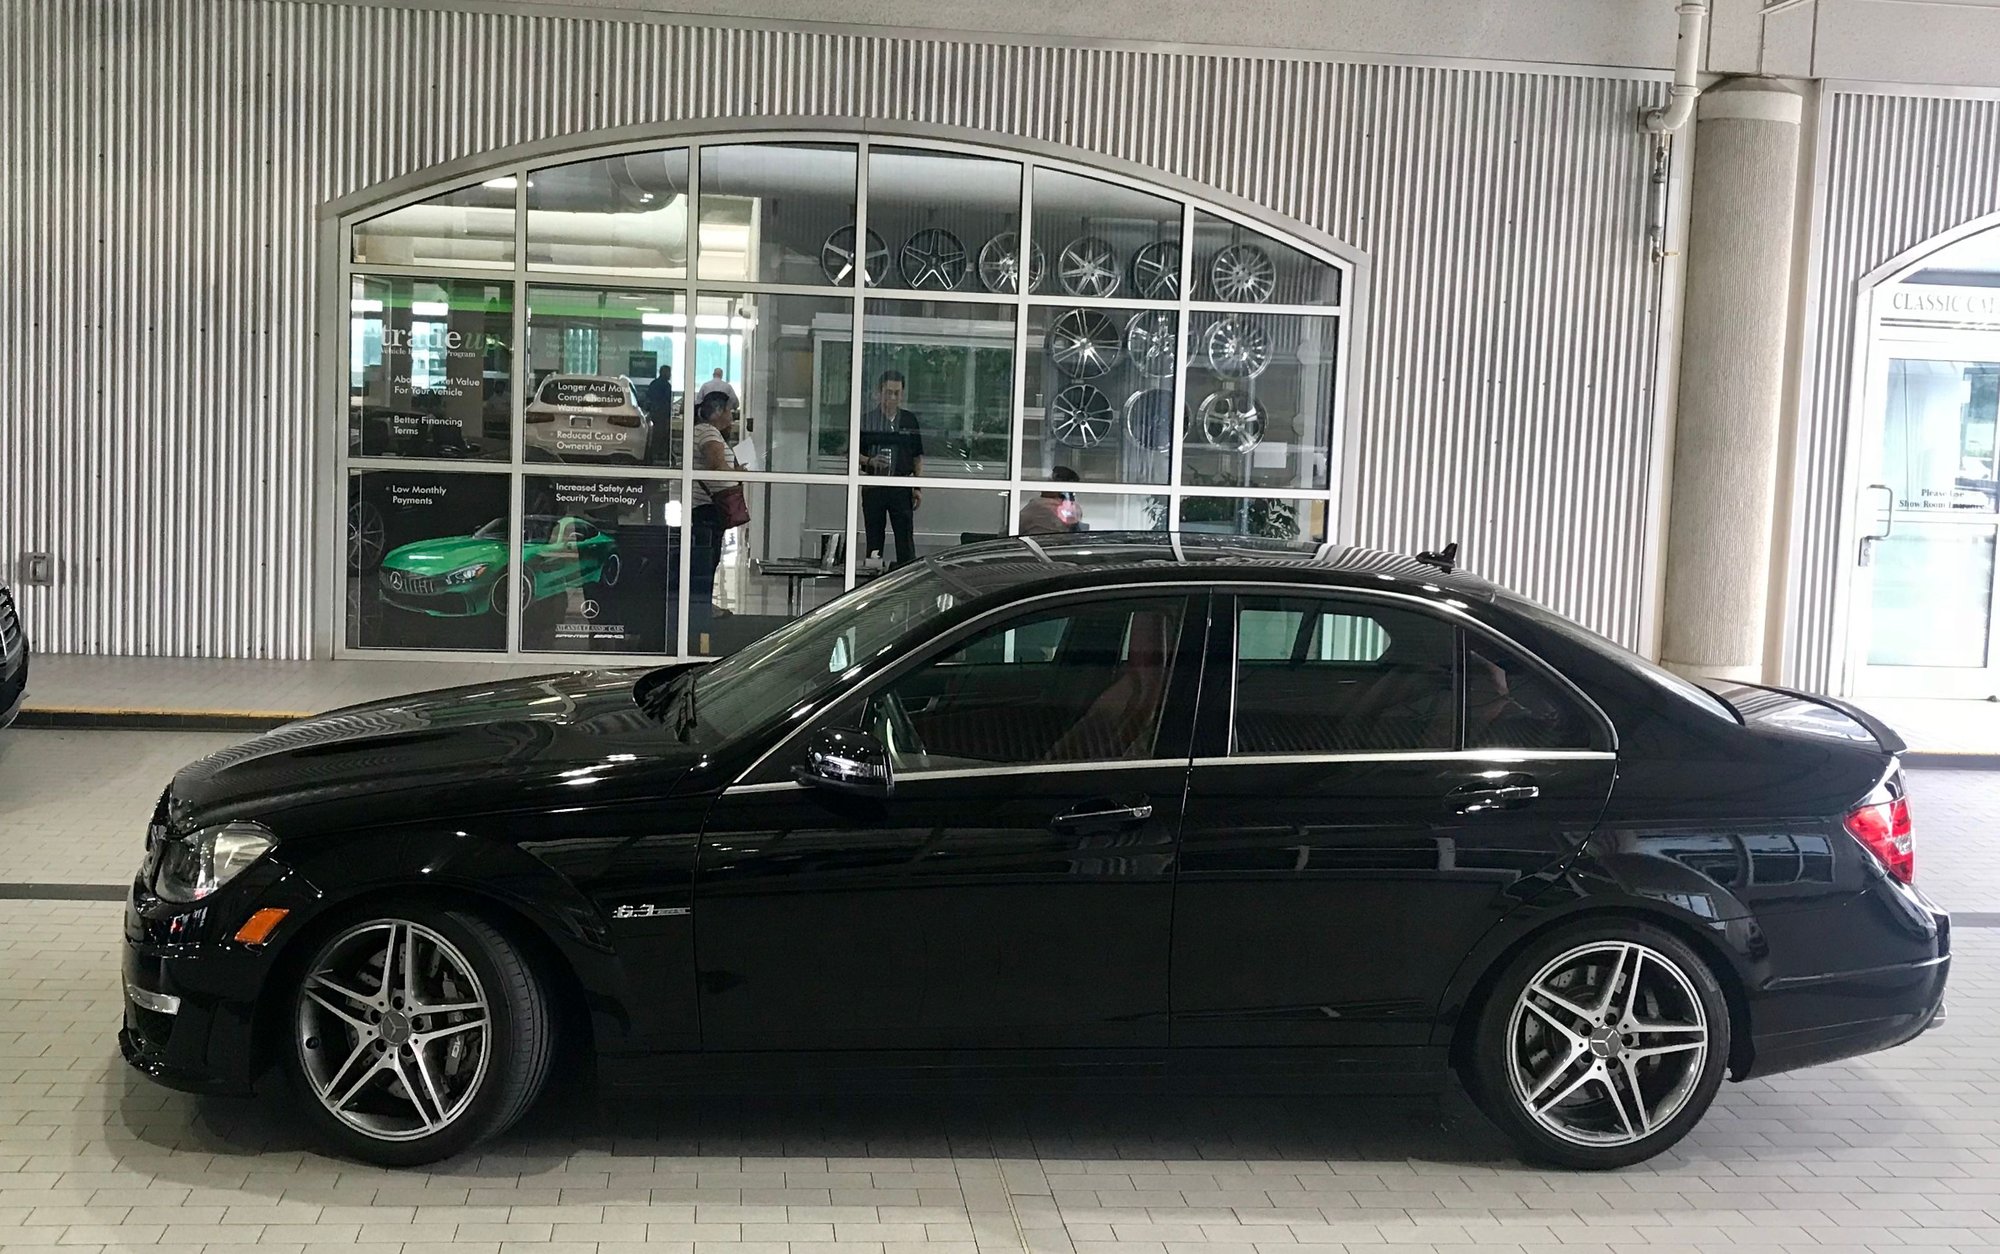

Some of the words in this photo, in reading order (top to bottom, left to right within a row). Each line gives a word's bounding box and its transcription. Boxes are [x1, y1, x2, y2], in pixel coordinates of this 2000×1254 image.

[1893, 292, 1959, 312] CLASSIC
[456, 377, 481, 387] Value
[394, 386, 409, 395] For
[410, 386, 431, 396] Your
[432, 388, 464, 397] Vehicle
[557, 382, 587, 392] Longer
[588, 383, 607, 393] And
[608, 385, 631, 394] More
[557, 393, 623, 404] Comprehensive
[557, 404, 603, 413] Warranties
[394, 414, 420, 424] Better
[421, 416, 464, 428] Financing
[394, 426, 420, 436] Terms
[557, 431, 592, 441] Reduced
[594, 432, 614, 441] Cost
[615, 432, 628, 441] Of
[556, 441, 603, 453] Ownership
[393, 485, 410, 494] Low
[411, 485, 447, 496] Monthly
[556, 482, 597, 492] Increased
[598, 484, 625, 495] Safety
[626, 485, 644, 494] And
[393, 495, 433, 506] Payments
[556, 493, 588, 504] Security
[590, 494, 638, 506] Technology
[1899, 499, 1921, 509] Show
[1922, 500, 1946, 509] Room
